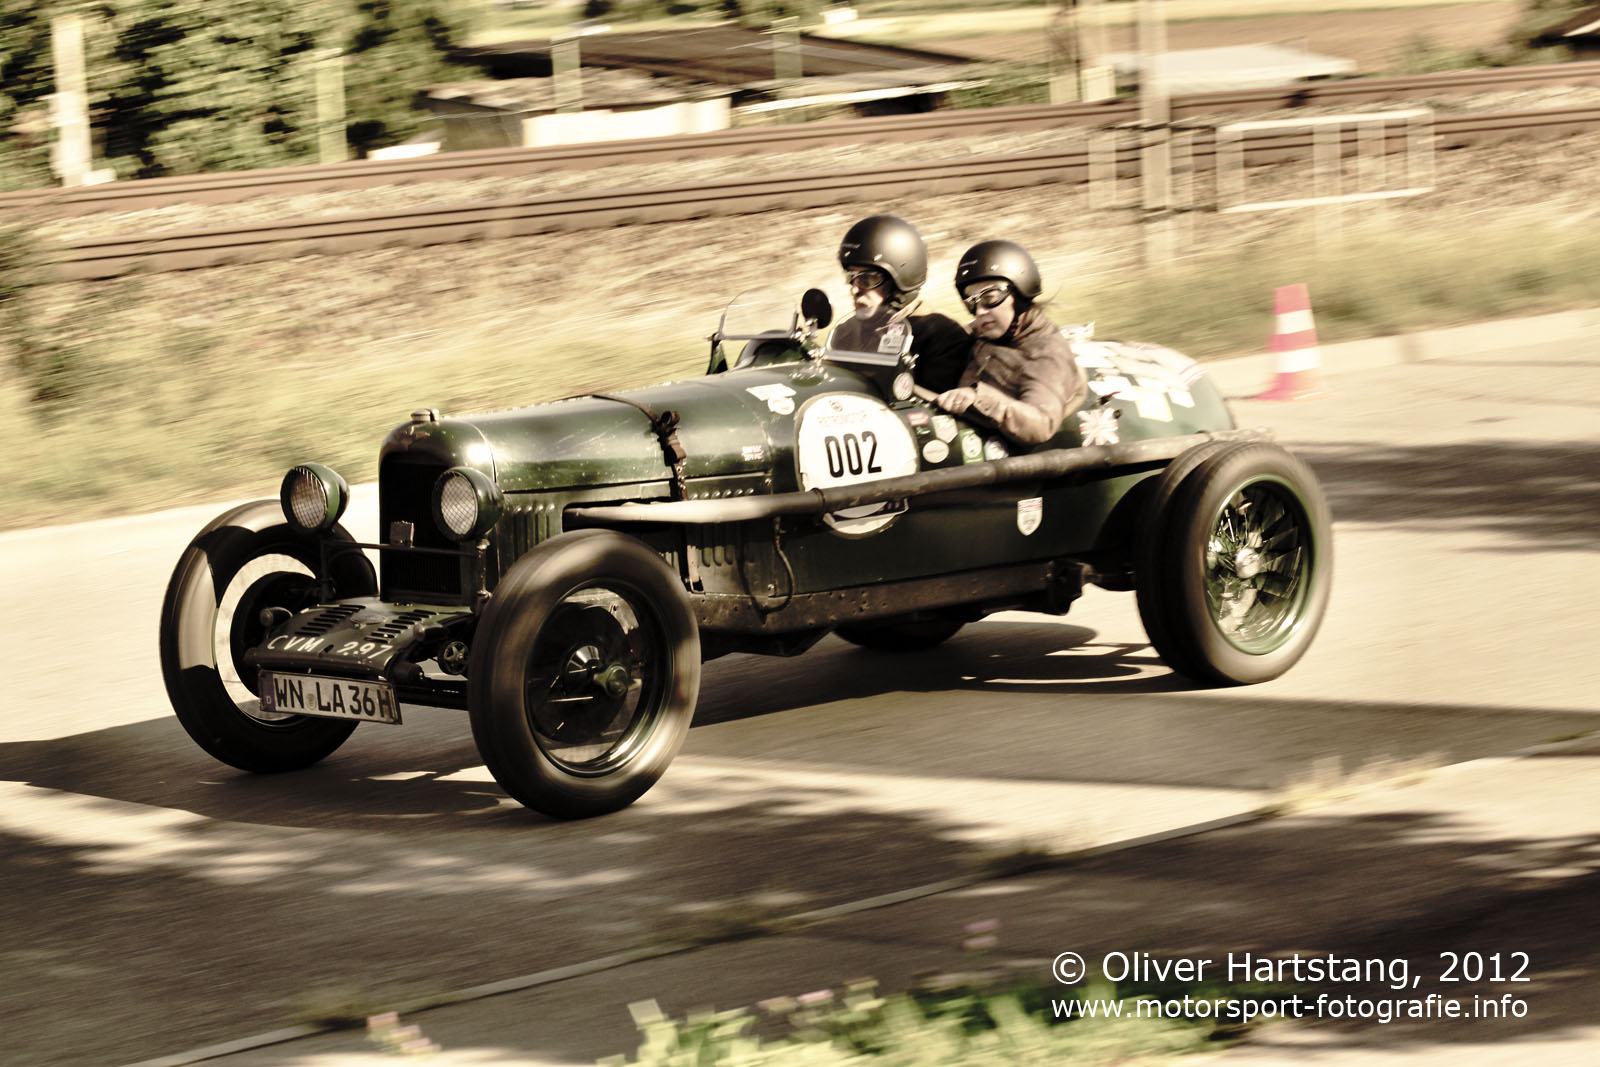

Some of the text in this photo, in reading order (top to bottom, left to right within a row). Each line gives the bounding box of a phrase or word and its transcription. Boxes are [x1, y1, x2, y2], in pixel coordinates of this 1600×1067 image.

[824, 430, 882, 478] 002
[267, 635, 324, 652] CVM
[274, 678, 304, 709] WN
